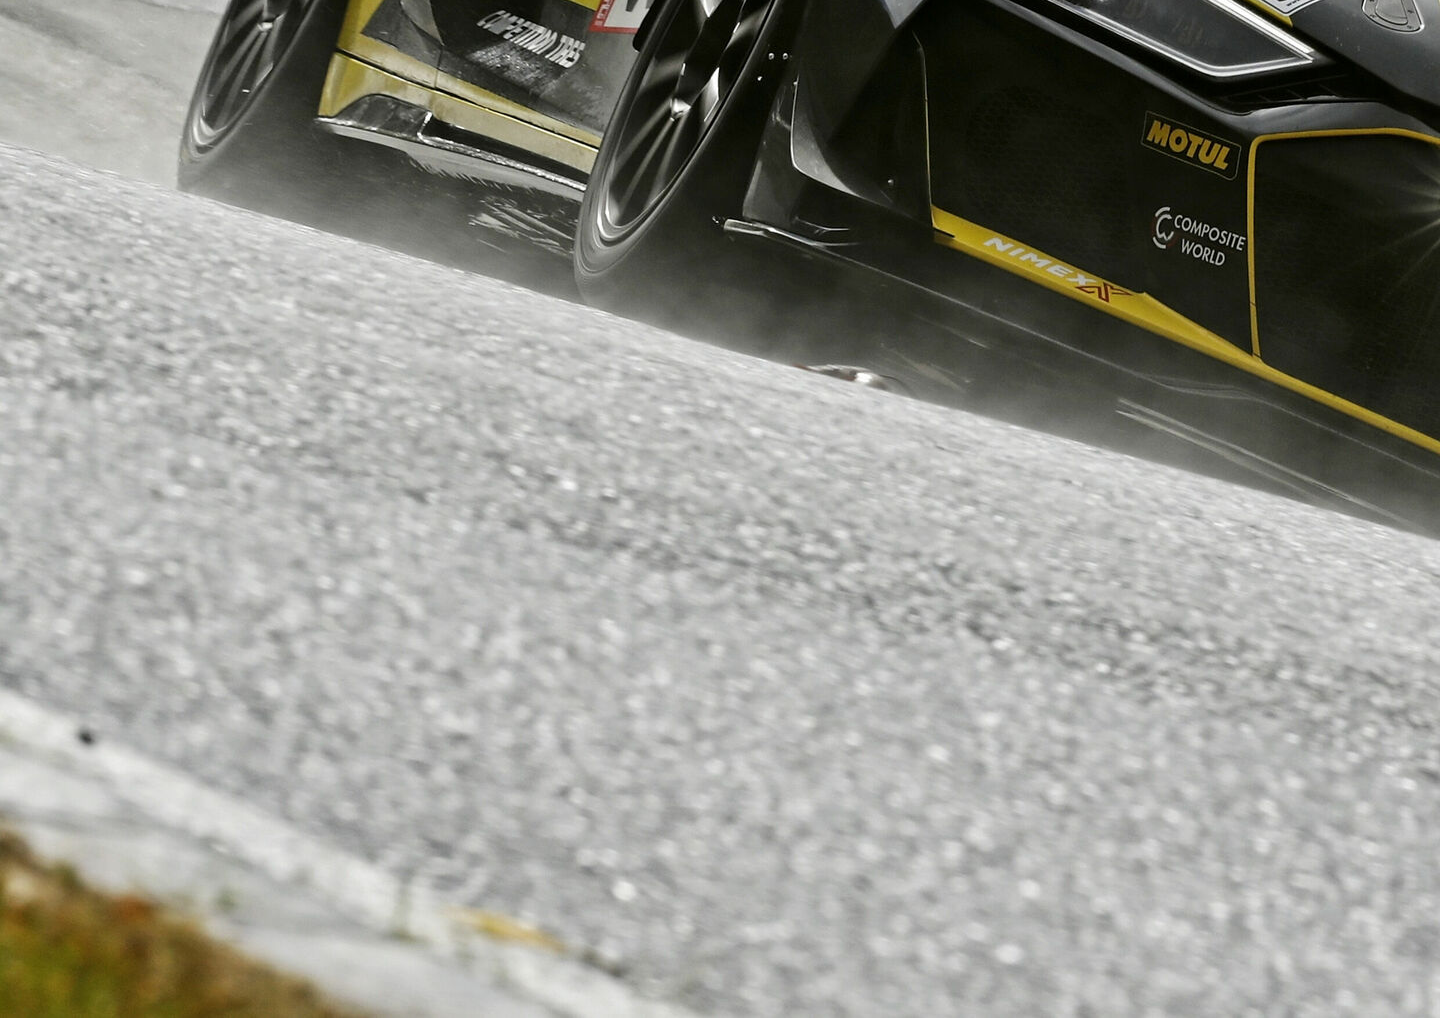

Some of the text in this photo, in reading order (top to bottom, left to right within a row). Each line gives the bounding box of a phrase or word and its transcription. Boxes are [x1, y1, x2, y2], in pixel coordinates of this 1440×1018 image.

[544, 34, 586, 69] TIRES
[1146, 119, 1231, 171] MOTUL
[1174, 214, 1246, 252] COMPOSITE
[983, 236, 1097, 286] NIMEX
[1180, 238, 1226, 267] WORLD
